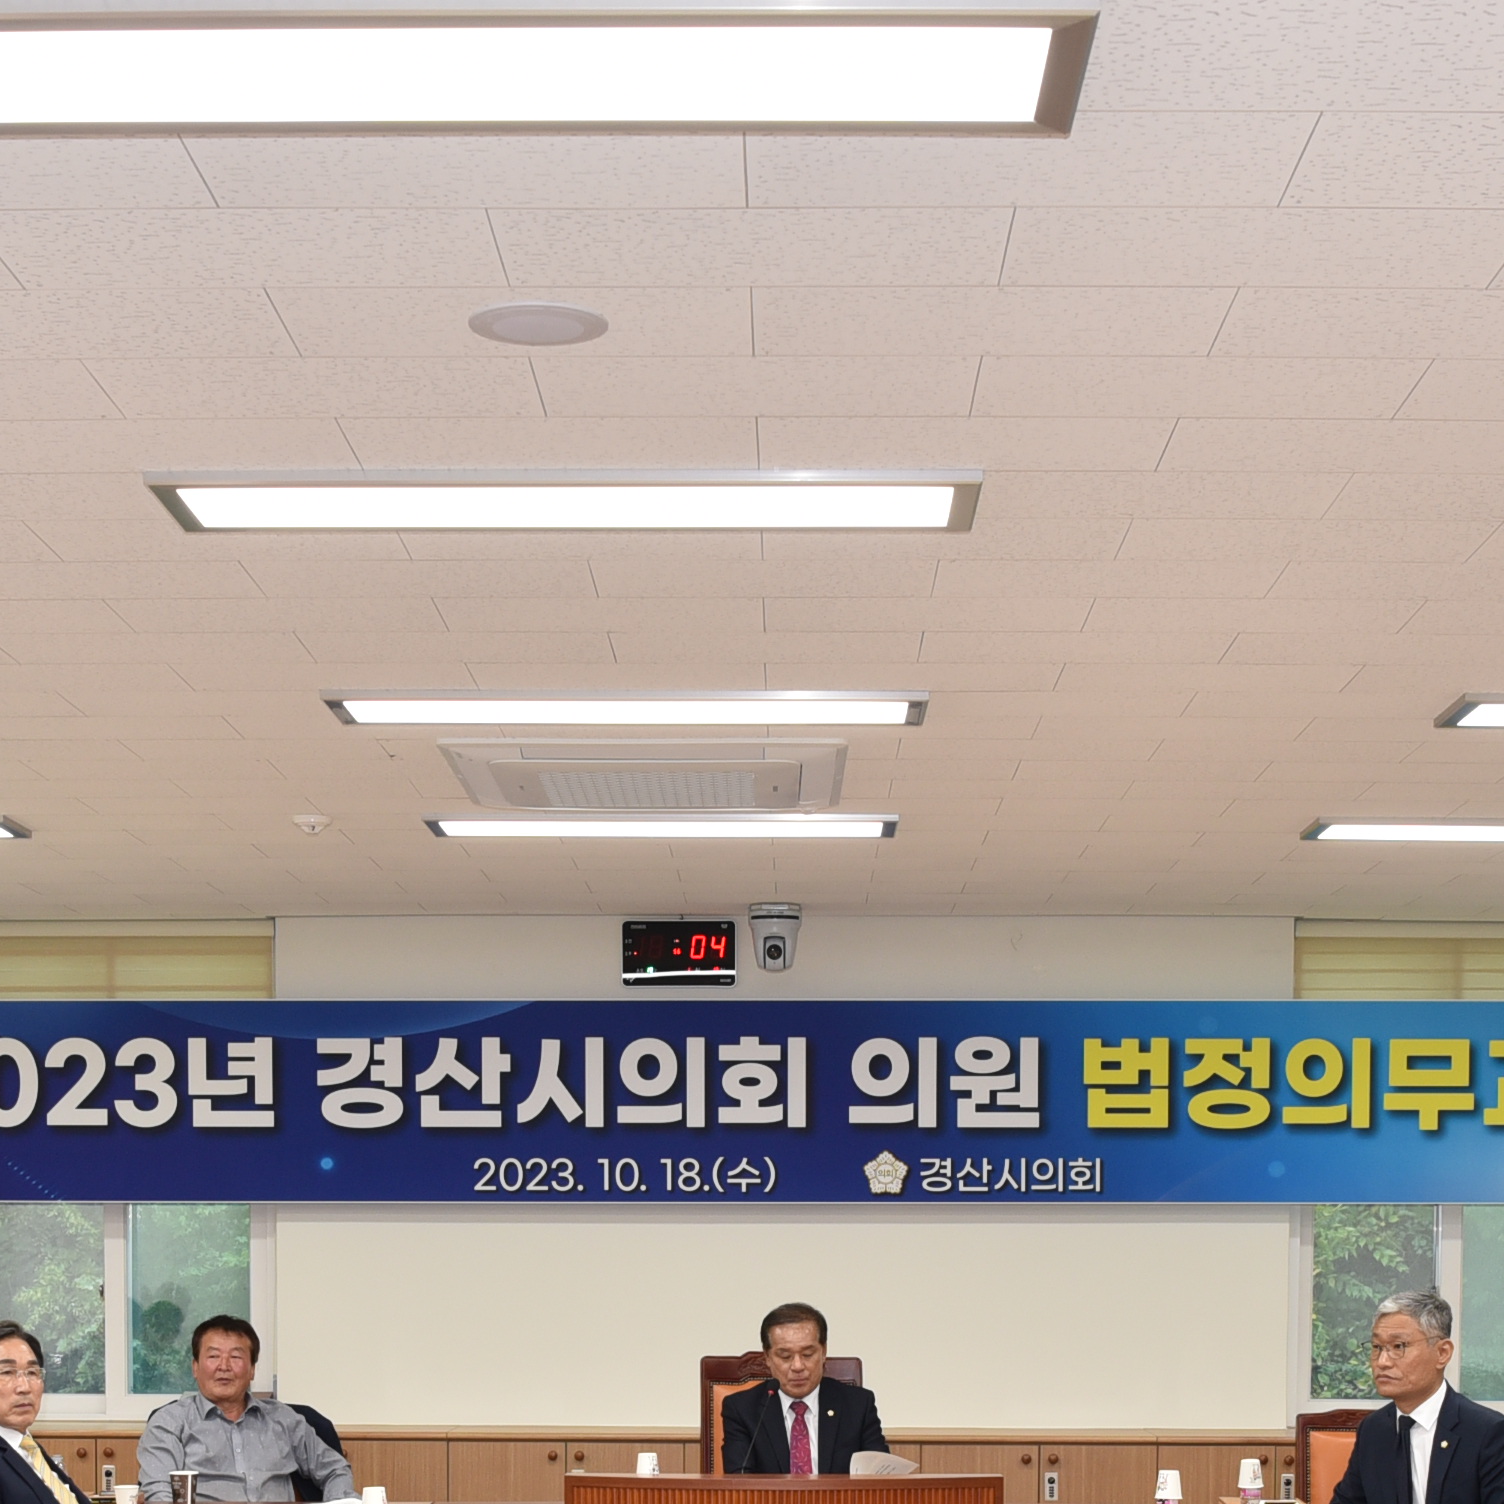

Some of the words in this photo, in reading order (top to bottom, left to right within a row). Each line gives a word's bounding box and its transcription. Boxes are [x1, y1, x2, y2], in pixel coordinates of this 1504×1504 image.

[316, 1036, 807, 1129] 경산시의회
[848, 1036, 1040, 1128] 의원
[473, 1157, 584, 1192] 2023.
[597, 1157, 647, 1192] 10.
[660, 1156, 776, 1193] 18.(수)
[920, 1157, 1101, 1192] 경산시의회
